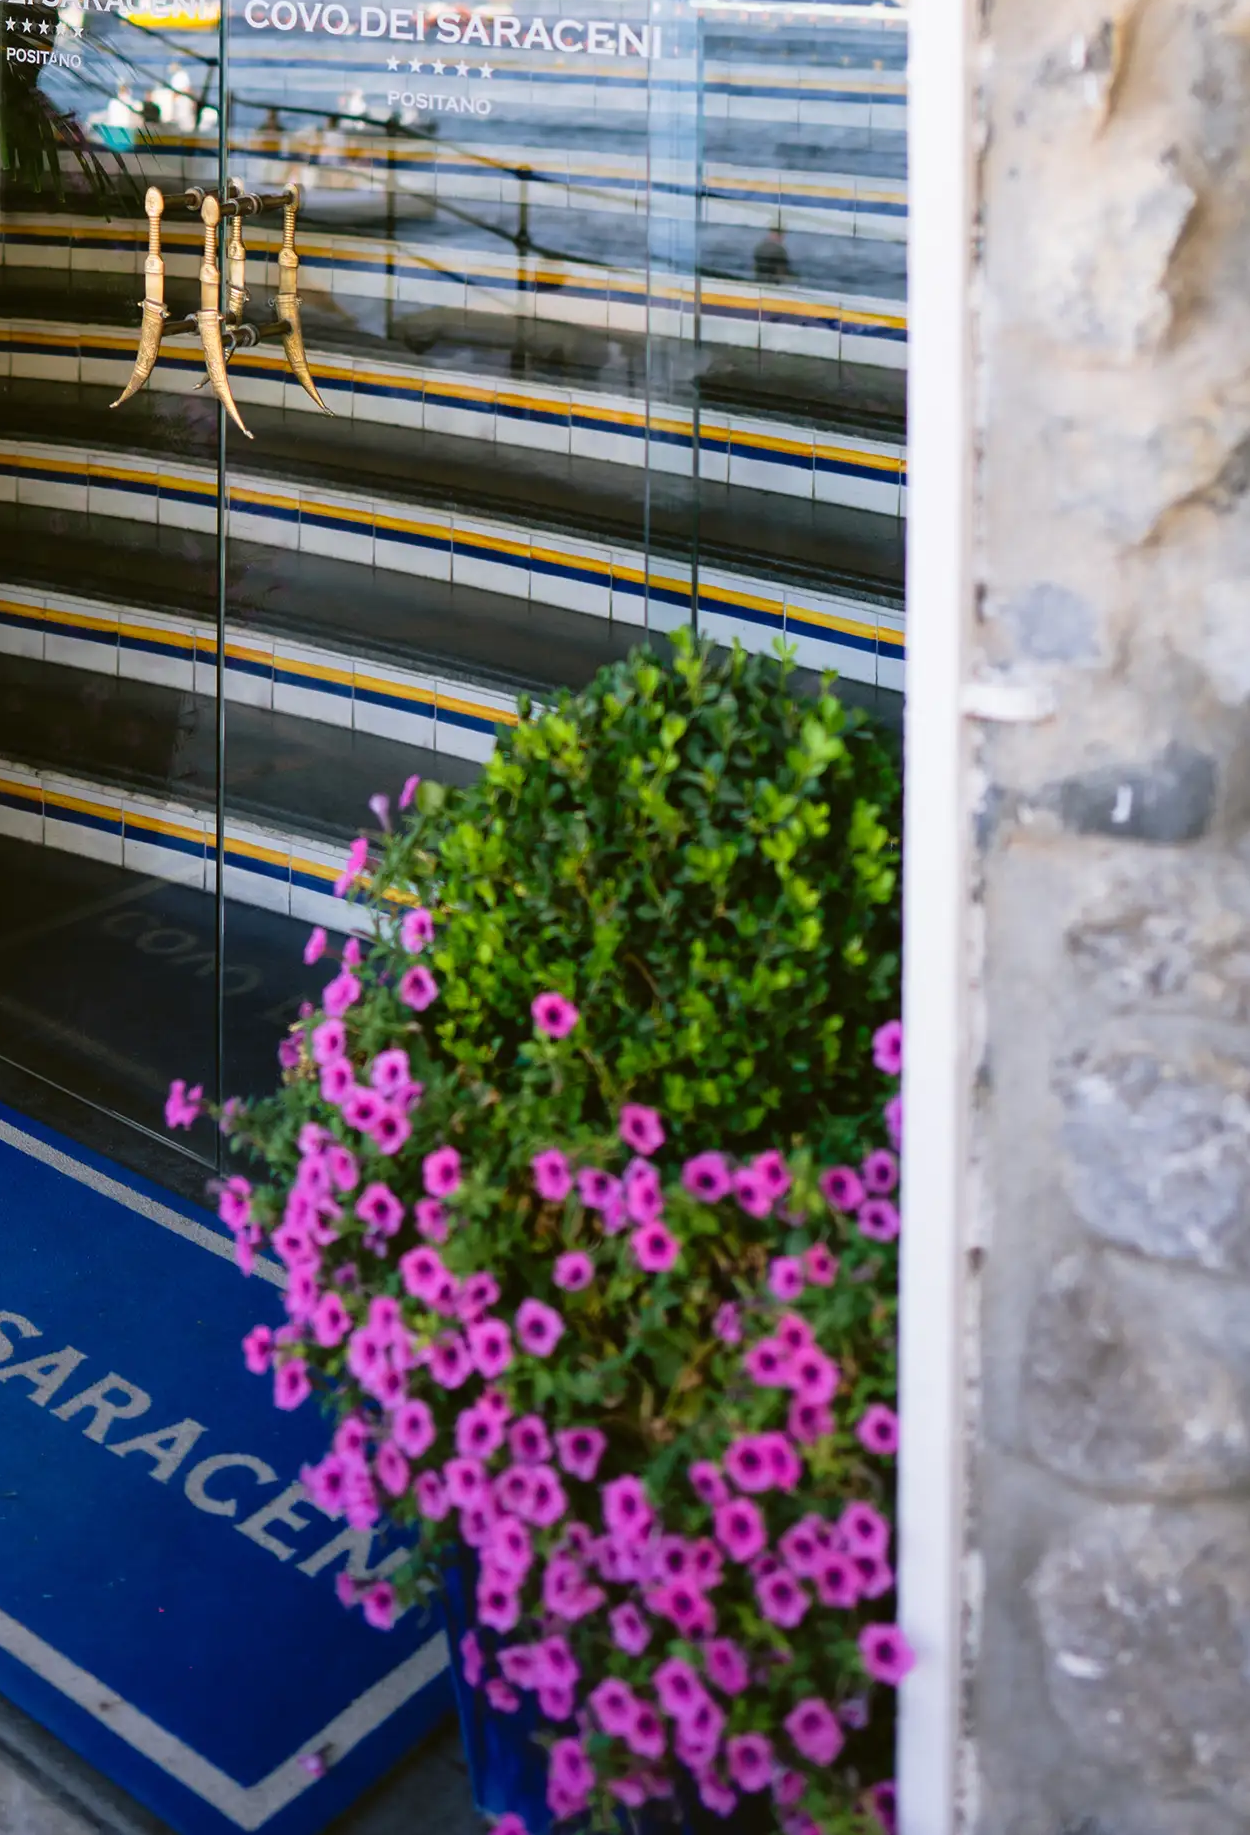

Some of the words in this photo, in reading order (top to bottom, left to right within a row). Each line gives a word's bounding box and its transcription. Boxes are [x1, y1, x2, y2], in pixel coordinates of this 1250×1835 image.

[244, 0, 350, 36] COVO
[360, 6, 426, 41] DEI
[436, 13, 662, 59] SARACENI
[6, 46, 82, 68] POSITANO
[387, 90, 491, 115] POSITANO
